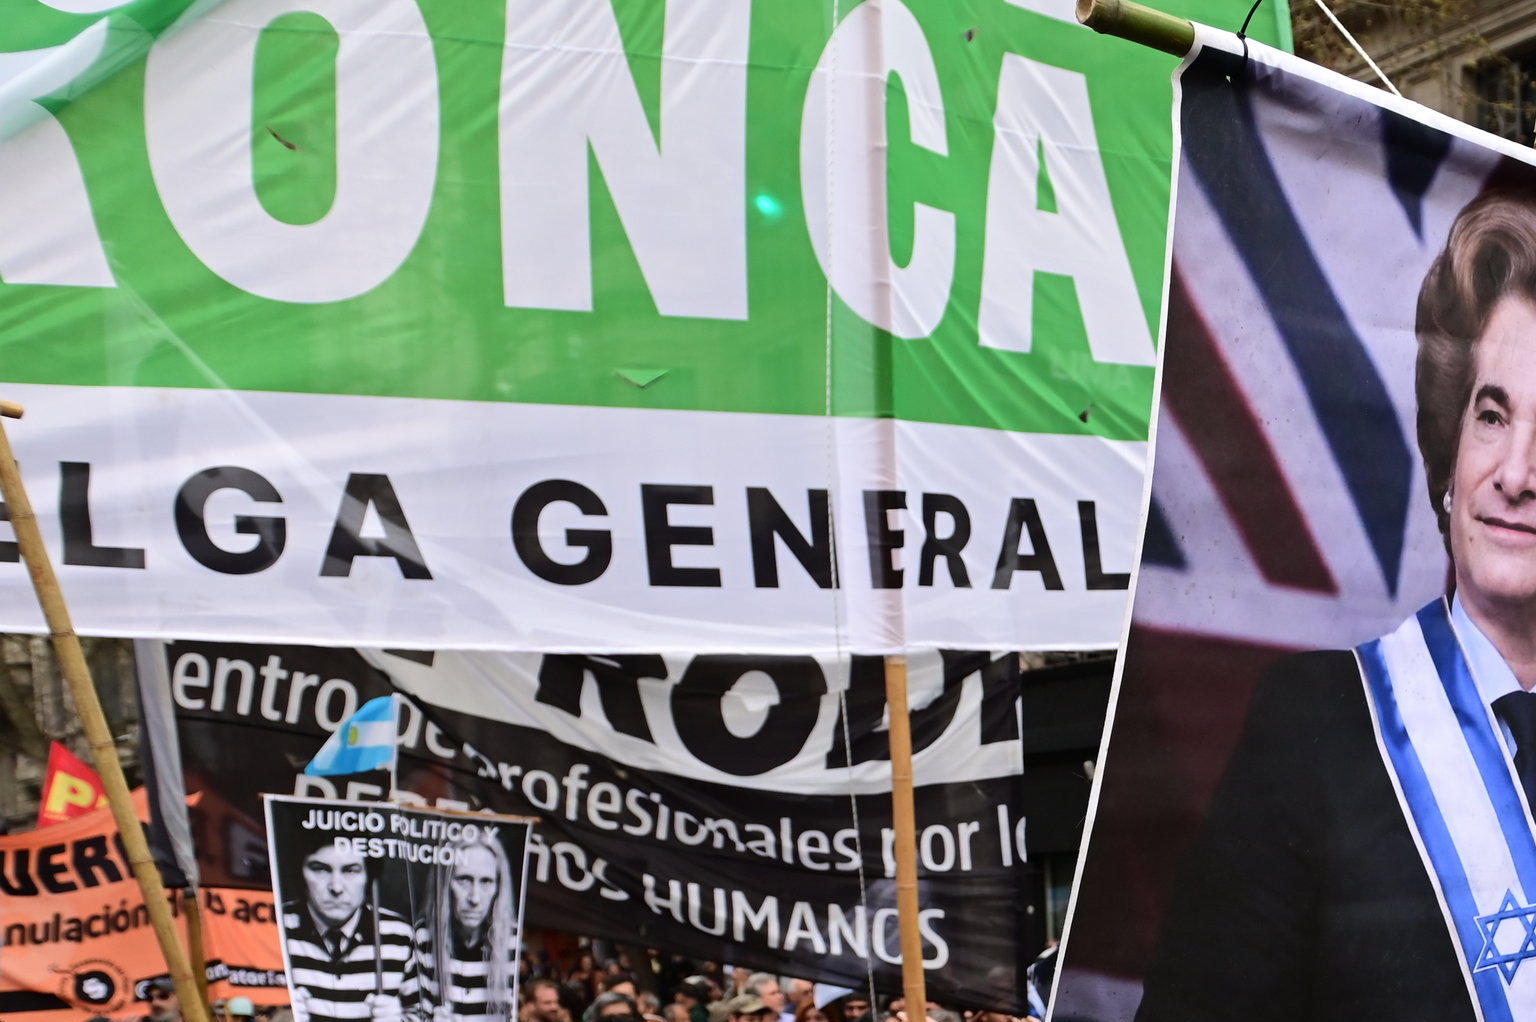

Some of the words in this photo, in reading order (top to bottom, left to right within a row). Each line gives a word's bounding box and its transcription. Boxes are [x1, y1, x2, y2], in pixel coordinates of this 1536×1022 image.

[0, 460, 433, 580] LGA
[510, 479, 1131, 592] GENERAL
[0, 821, 150, 896] UER
[302, 809, 386, 833] JUICIO
[390, 813, 480, 843] POLITICO
[484, 826, 499, 846] Y
[642, 873, 949, 970] HUMANOS
